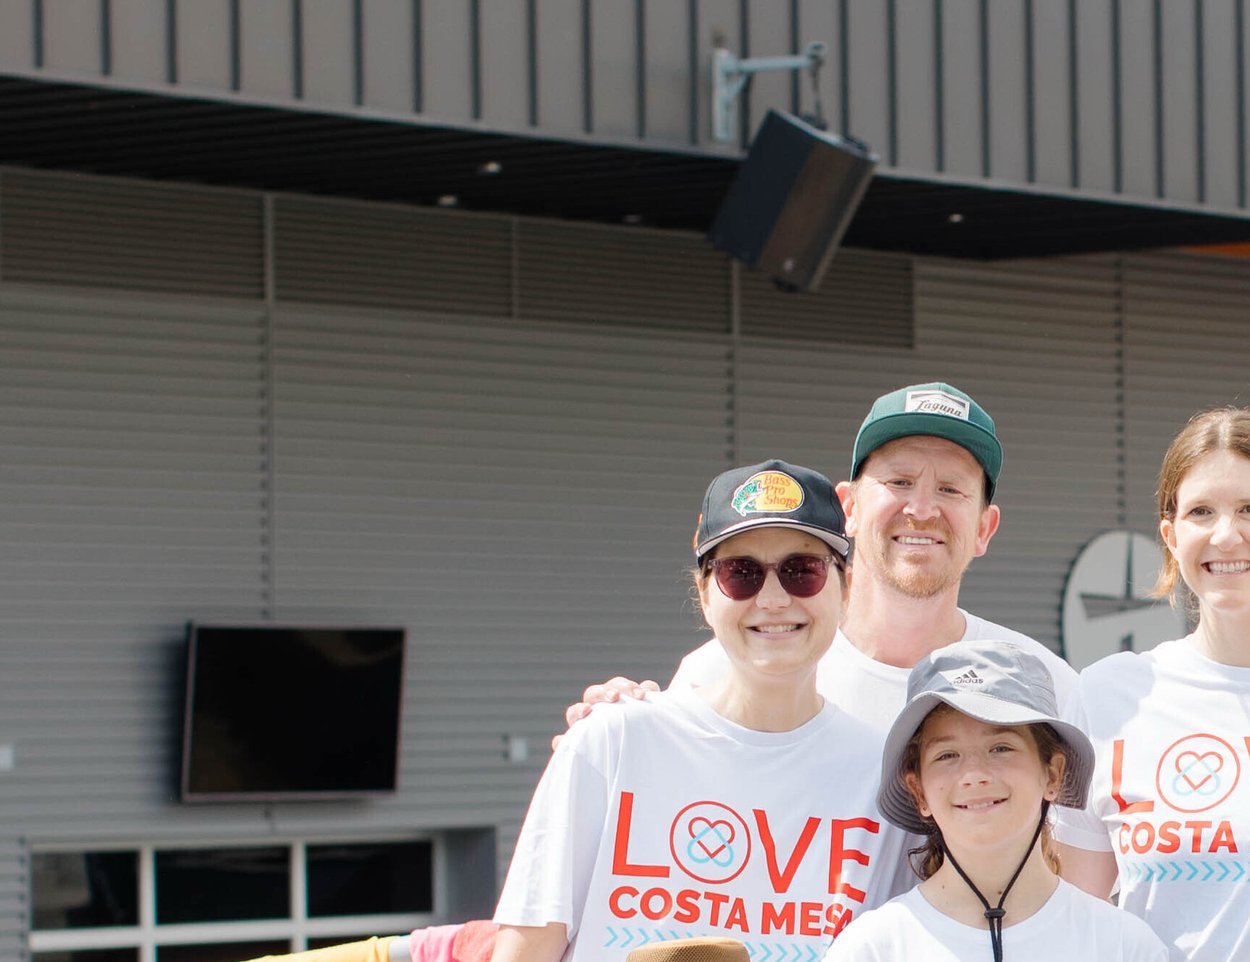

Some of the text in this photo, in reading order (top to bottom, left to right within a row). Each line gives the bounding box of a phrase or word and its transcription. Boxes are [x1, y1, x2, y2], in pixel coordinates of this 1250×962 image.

[915, 399, 963, 417] Laguna
[763, 474, 792, 486] Bass
[764, 485, 786, 496] Pro
[764, 495, 799, 509] Shops
[1119, 820, 1239, 855] COSTA
[611, 791, 881, 904] LOVE
[608, 885, 750, 934] COSTA
